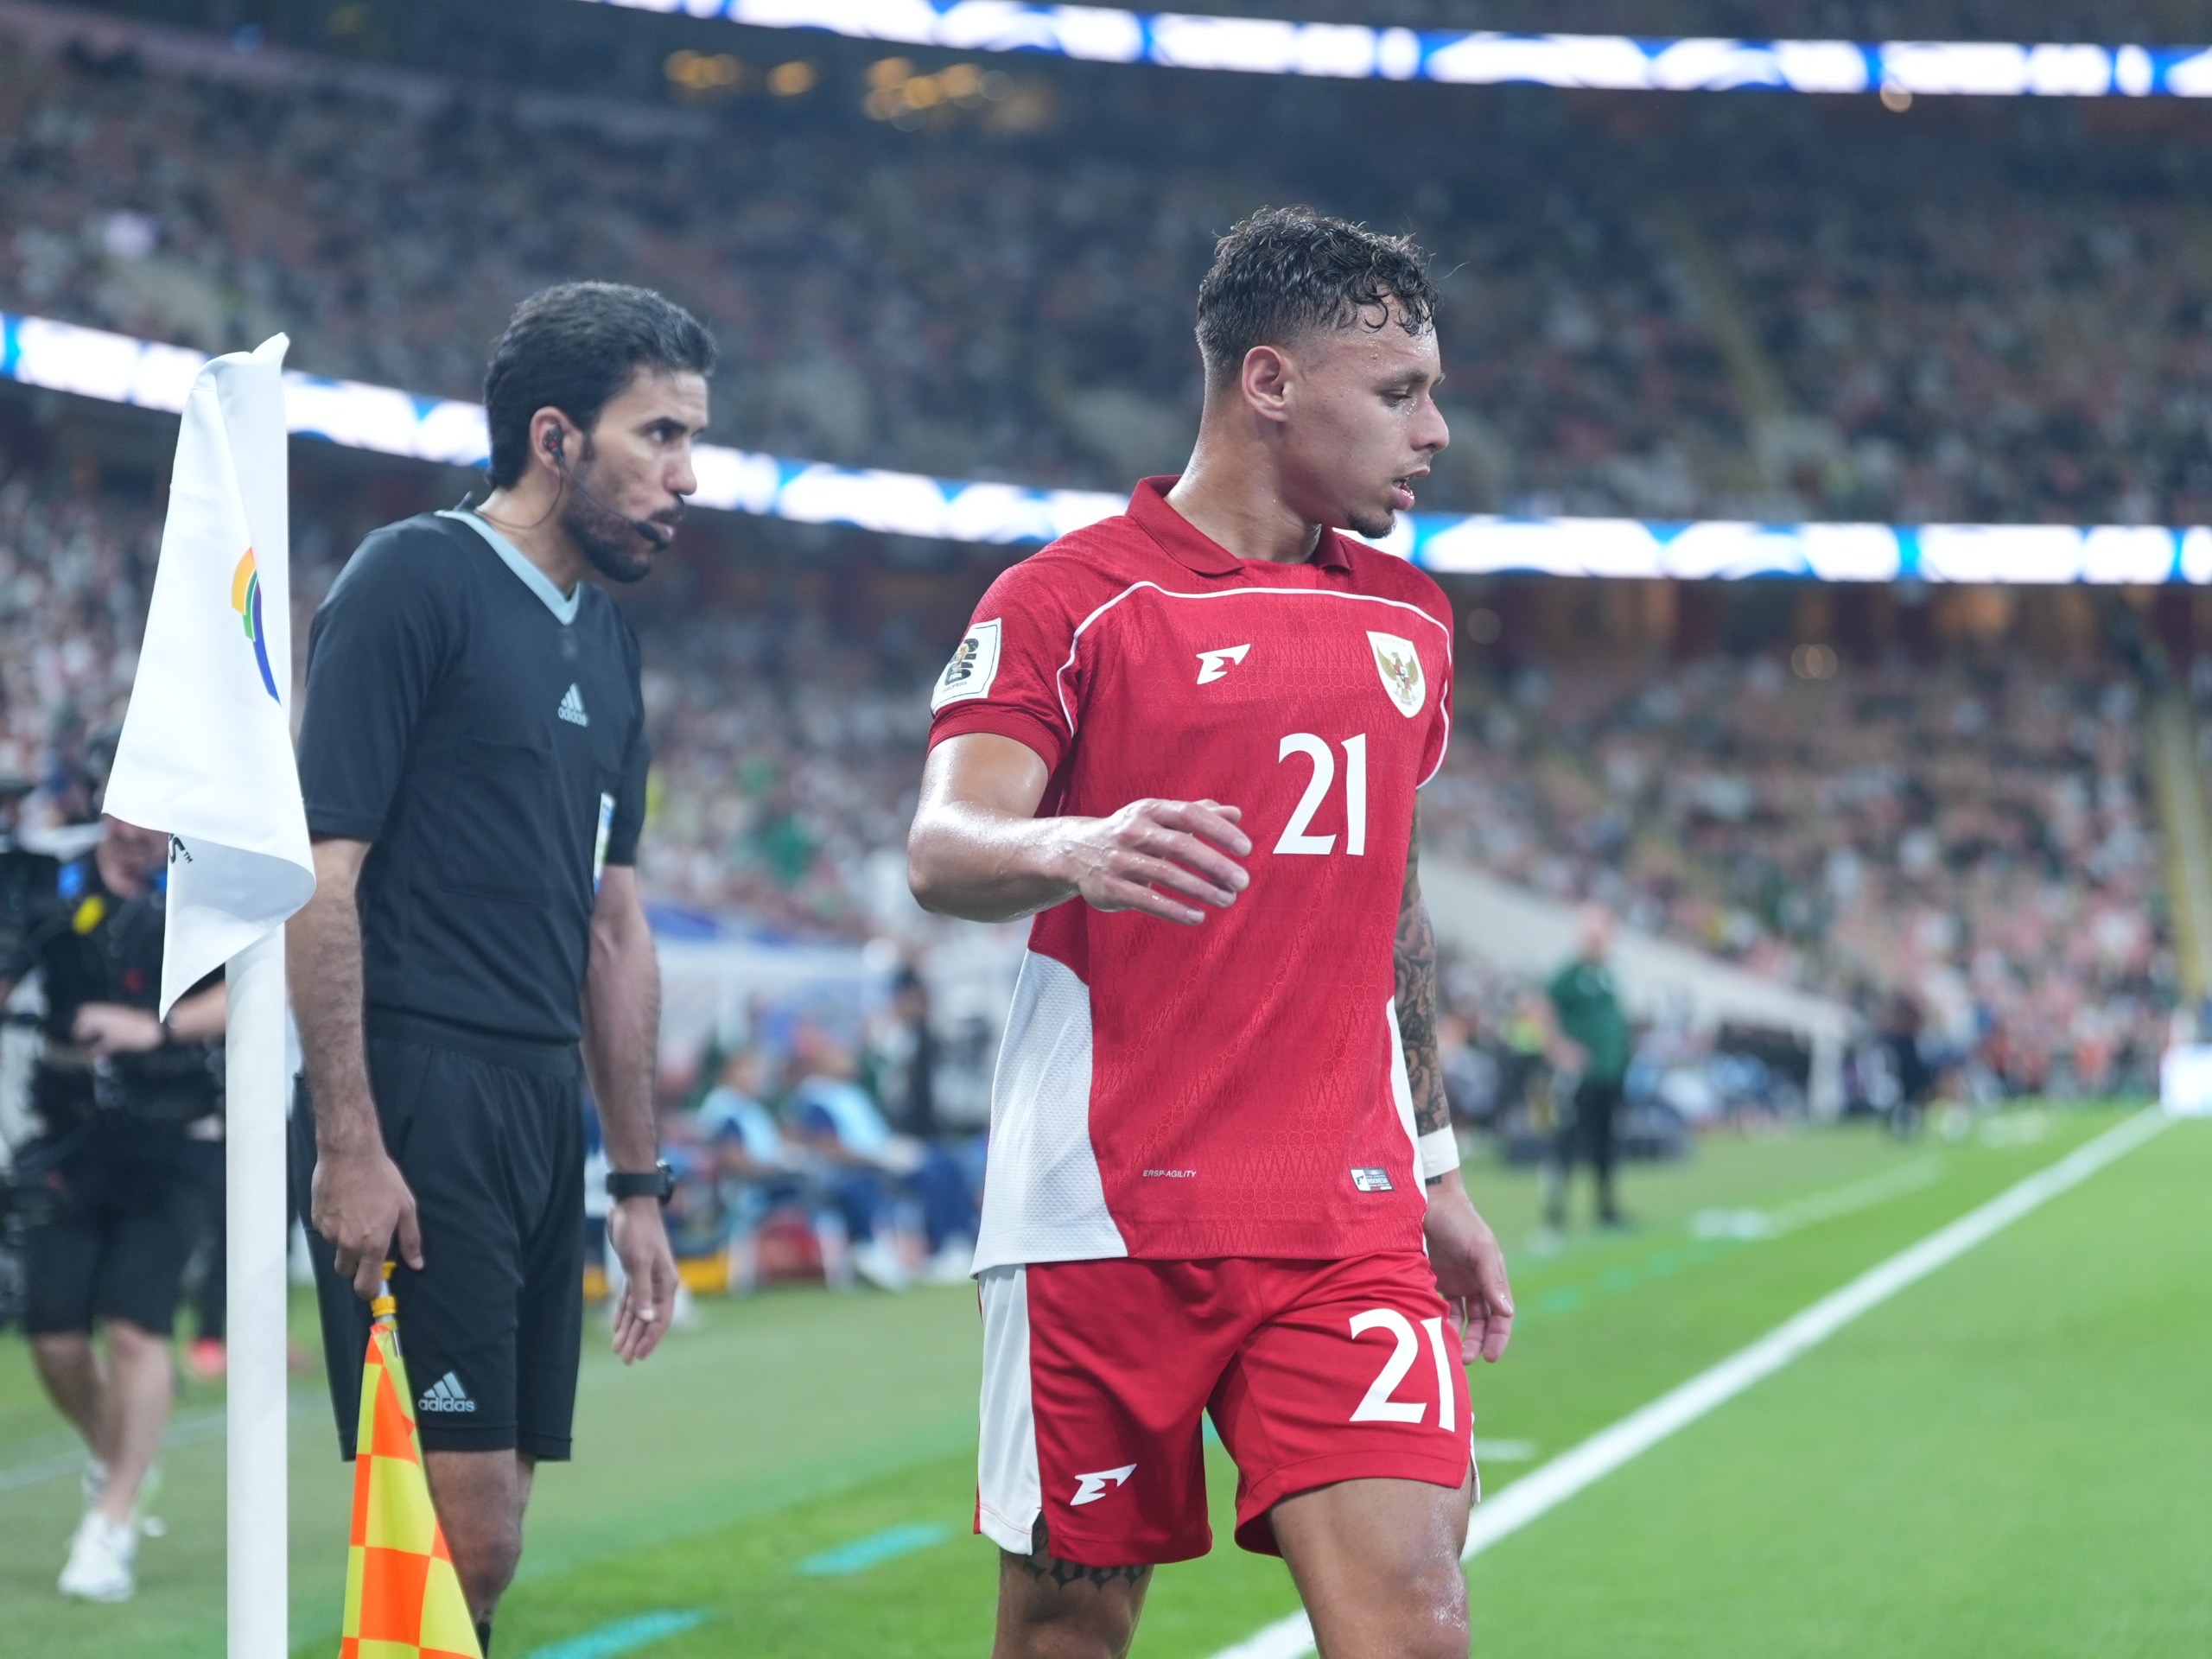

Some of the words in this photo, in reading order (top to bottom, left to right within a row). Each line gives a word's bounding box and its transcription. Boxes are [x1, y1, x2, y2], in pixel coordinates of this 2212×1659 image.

[1273, 733, 1367, 855] 21
[418, 1396, 476, 1413] adidas
[1349, 1308, 1455, 1433] 21
